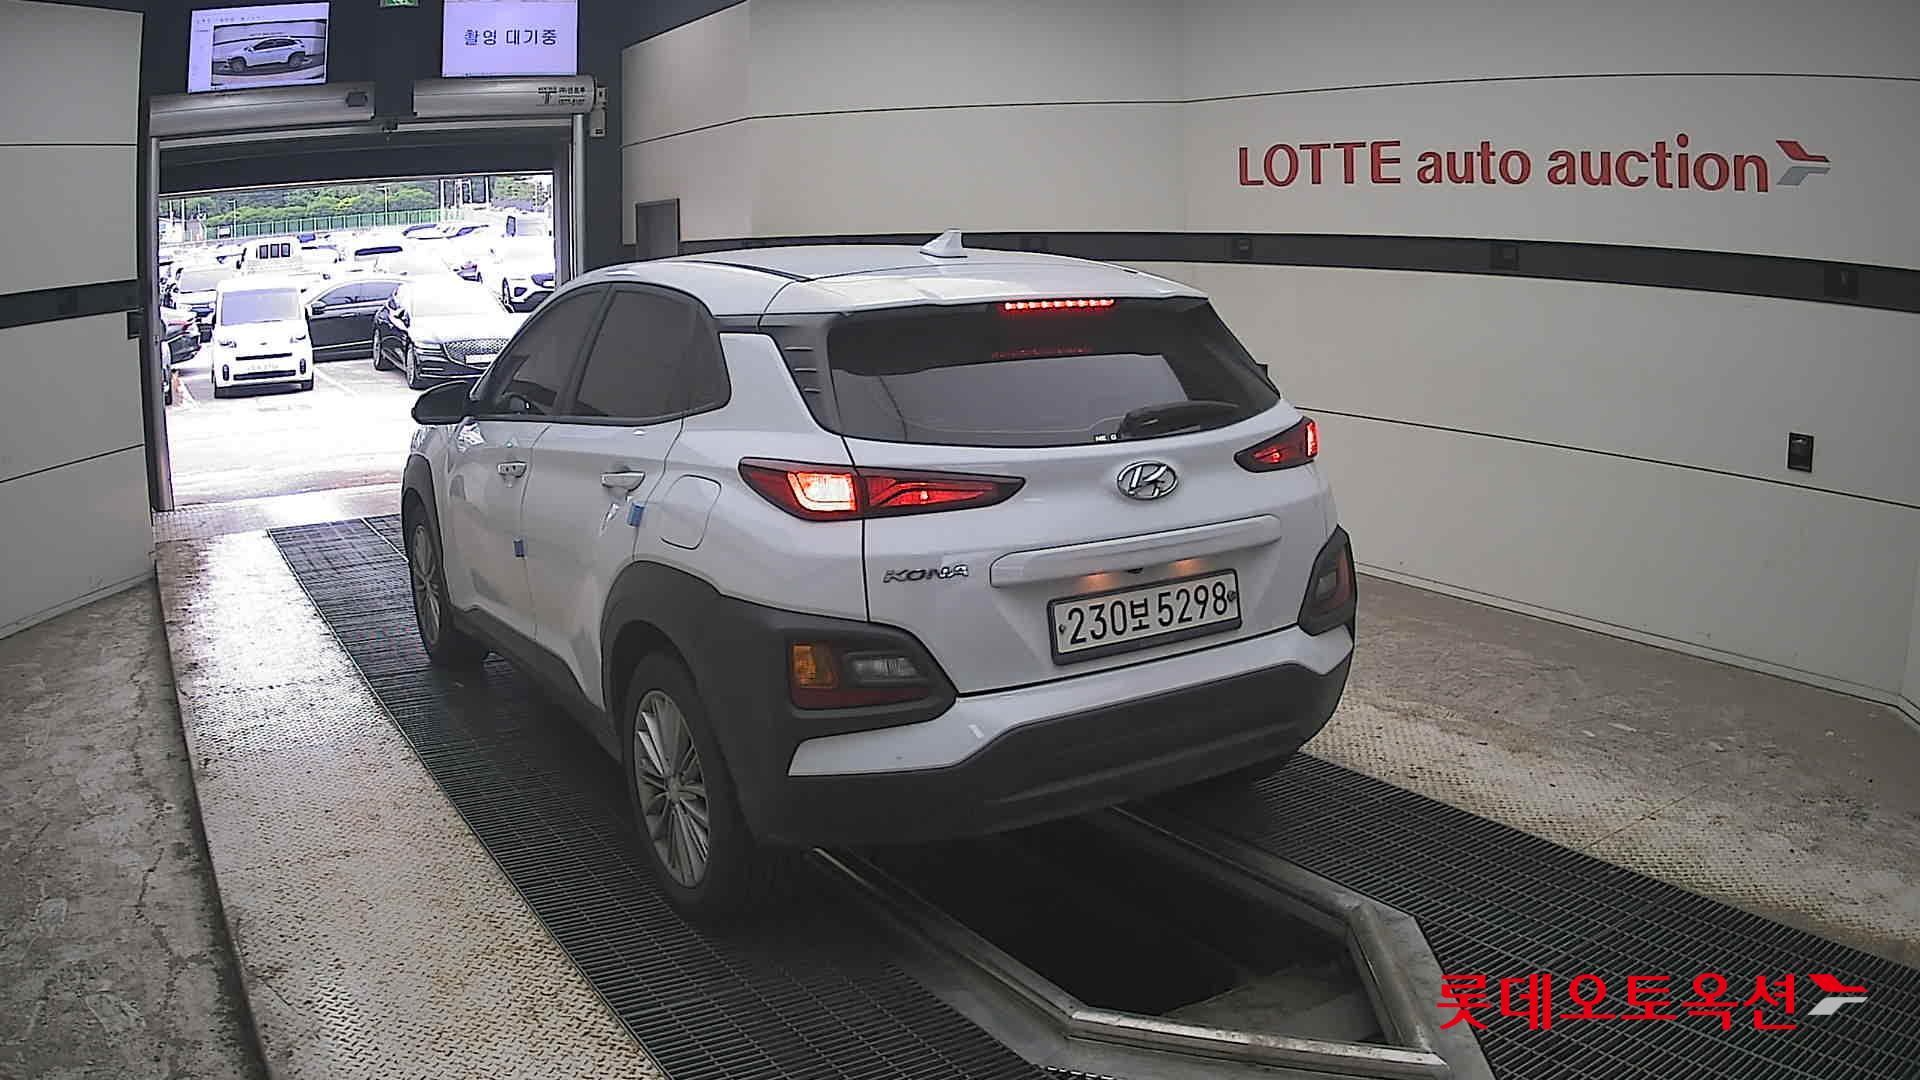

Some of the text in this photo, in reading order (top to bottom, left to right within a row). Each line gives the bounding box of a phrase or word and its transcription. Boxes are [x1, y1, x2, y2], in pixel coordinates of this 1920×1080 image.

[464, 28, 558, 46] 촬영 대기중
[1239, 133, 1768, 192] LOTTE auto auction
[883, 563, 970, 583] KONA
[1066, 581, 1229, 646] 230보 5298
